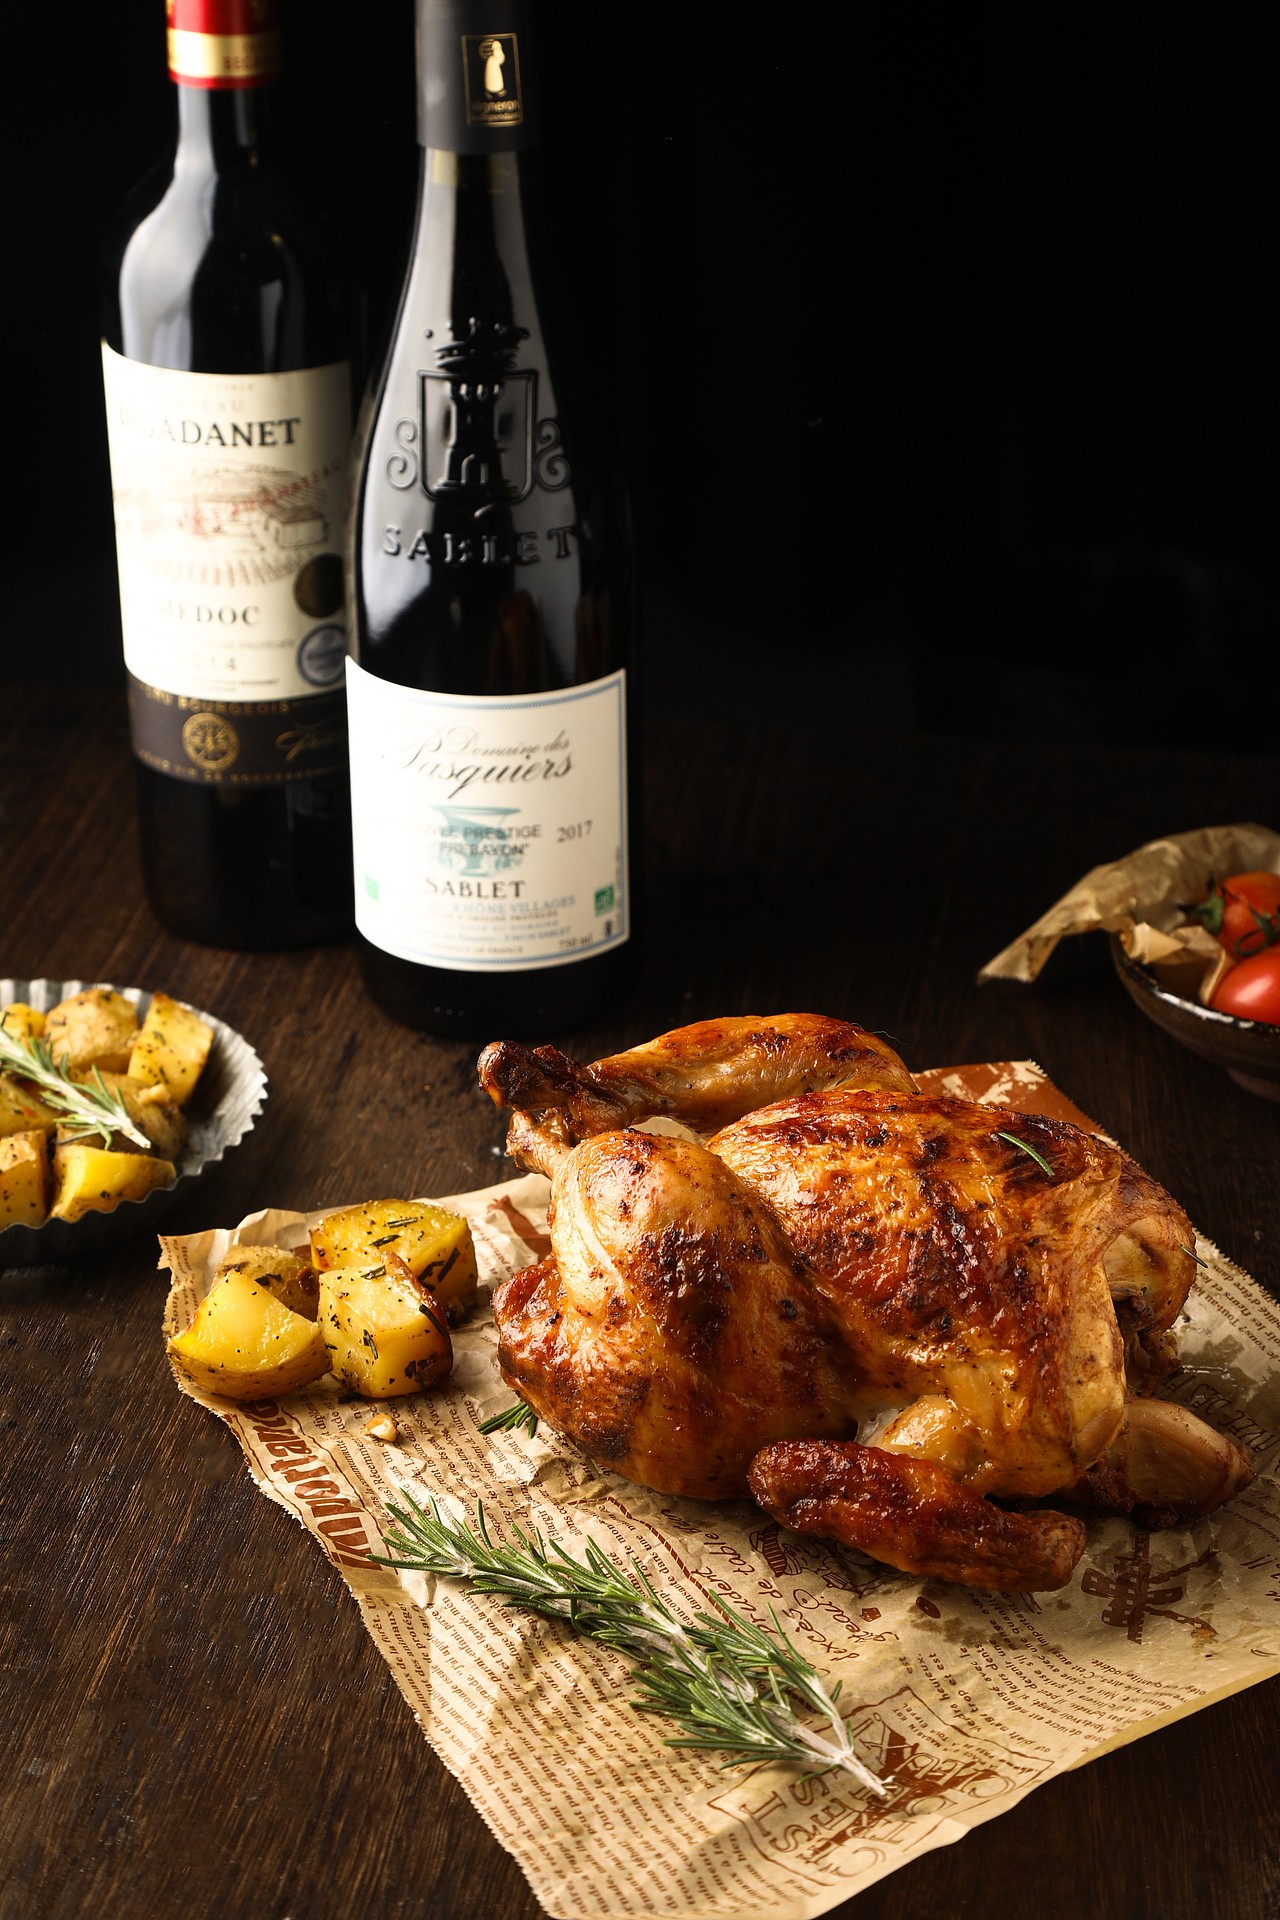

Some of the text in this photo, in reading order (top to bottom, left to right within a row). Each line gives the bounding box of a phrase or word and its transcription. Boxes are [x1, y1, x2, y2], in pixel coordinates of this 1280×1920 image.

[556, 820, 593, 843] 2017
[424, 878, 526, 900] SABLET
[1210, 1264, 1233, 1283] dans
[1210, 1283, 1264, 1331] les fleurs et
[1237, 1325, 1266, 1352] vous?
[443, 1409, 469, 1436] l'autre
[379, 1451, 393, 1463] un
[602, 1551, 624, 1567] été
[617, 1544, 636, 1555] le
[703, 1532, 756, 1576] table
[634, 1533, 703, 1612] dansante dans une
[758, 1578, 784, 1600] de
[389, 1600, 429, 1651] protéger
[417, 1614, 430, 1629] au
[429, 1609, 454, 1630] parce
[470, 1611, 487, 1621] la
[477, 1618, 503, 1638] dans
[491, 1607, 516, 1629] sont
[1004, 1601, 1051, 1647] important
[379, 1609, 415, 1659] animaux
[419, 1629, 454, 1657] appelé
[980, 1591, 1060, 1672] avec une quantité
[988, 1617, 1020, 1650] mange
[415, 1650, 434, 1664] de
[443, 1627, 503, 1684] parent-enfant,
[481, 1642, 503, 1657] pas
[494, 1636, 530, 1670] refuge
[404, 1658, 426, 1678] des
[426, 1663, 454, 1686] essaie
[490, 1658, 516, 1681] n'est
[581, 1647, 622, 1690] protéger
[600, 1652, 635, 1686] lieu de
[894, 1655, 914, 1675] est
[911, 1652, 950, 1701] heureux.
[955, 1646, 991, 1682] avec le
[970, 1643, 1019, 1694] leurs dents
[989, 1638, 1039, 1690] devenir une
[535, 1670, 563, 1694] votre
[924, 1652, 980, 1714] trop et est
[446, 1683, 479, 1710] monde
[555, 1693, 582, 1720] dans
[563, 1652, 654, 1748] vous dans votre
[367, 1613, 526, 1829] heureux tous et les animaux de la forêt.
[442, 1705, 487, 1742] Important
[469, 1709, 486, 1719] le
[476, 1716, 502, 1738] Tout
[494, 1704, 524, 1735] grosse
[507, 1703, 539, 1738] maison
[545, 1659, 672, 1795] Enfants de rat est maintenant
[890, 1708, 906, 1721] EST
[518, 1734, 536, 1752] une
[532, 1736, 553, 1750] La
[569, 1734, 588, 1746] le
[477, 1742, 504, 1770] forêt.
[616, 1752, 637, 1768] pas
[495, 1770, 512, 1781] la
[532, 1752, 565, 1789] gagner
[586, 1778, 604, 1790] le
[625, 1769, 656, 1795] peut
[504, 1781, 523, 1795] de
[559, 1767, 595, 1803] enfants
[560, 1788, 581, 1808] pas
[600, 1789, 619, 1806] sur
[460, 1776, 514, 1839] parent et son
[515, 1794, 550, 1831] monde
[586, 1803, 615, 1832] Ours
[650, 1796, 676, 1824] assez
[569, 1809, 599, 1837] peut
[610, 1806, 643, 1841] creusé
[592, 1836, 607, 1848] ne
[636, 1839, 656, 1853] été
[655, 1859, 679, 1878] qui
